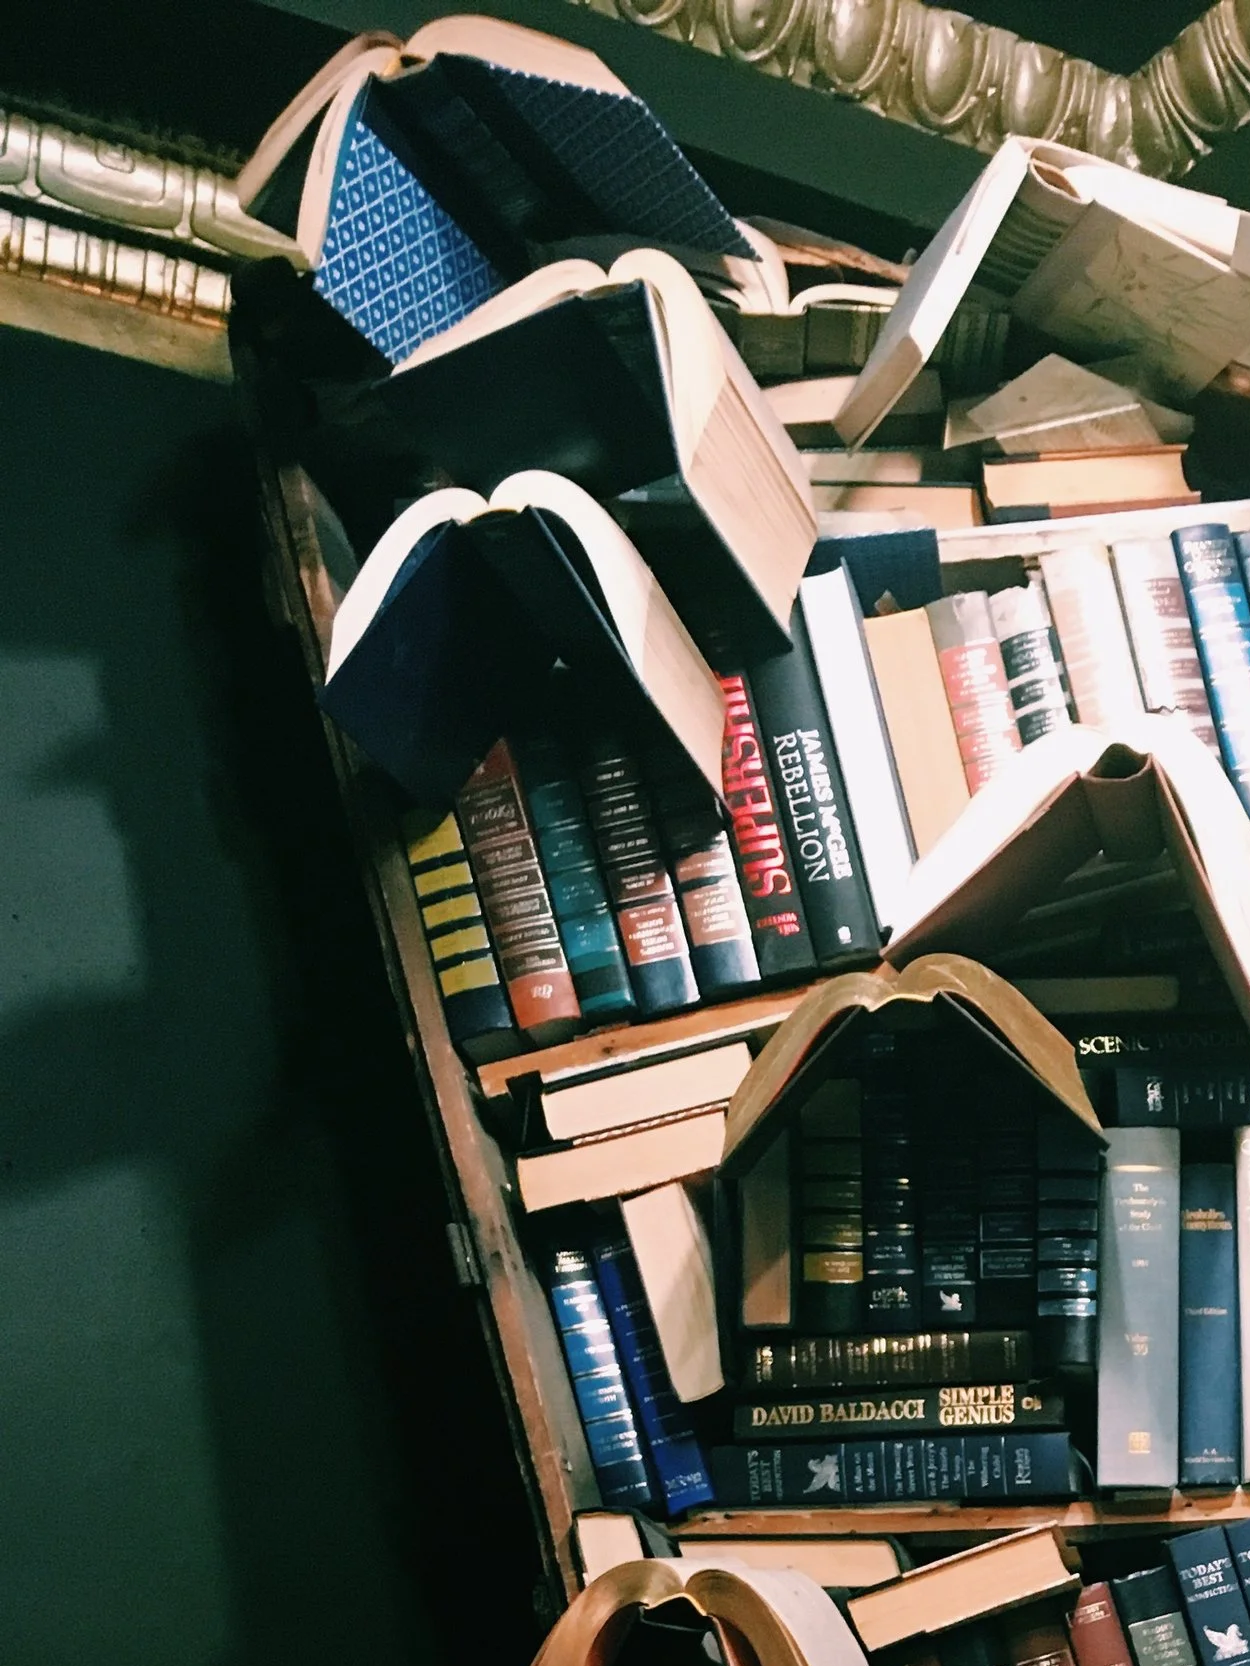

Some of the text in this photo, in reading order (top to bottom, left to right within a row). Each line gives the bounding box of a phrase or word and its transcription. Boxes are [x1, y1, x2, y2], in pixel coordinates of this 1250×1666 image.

[797, 728, 834, 803] JAMES
[773, 731, 830, 883] REBELLION
[1131, 1183, 1148, 1192] The
[939, 1385, 1014, 1406] SIMPLE
[752, 1400, 925, 1426] DAVID BALDACCI
[939, 1404, 1015, 1426] GENIUS
[1179, 1557, 1233, 1581] TODAY'S
[1192, 1572, 1224, 1589] BEST
